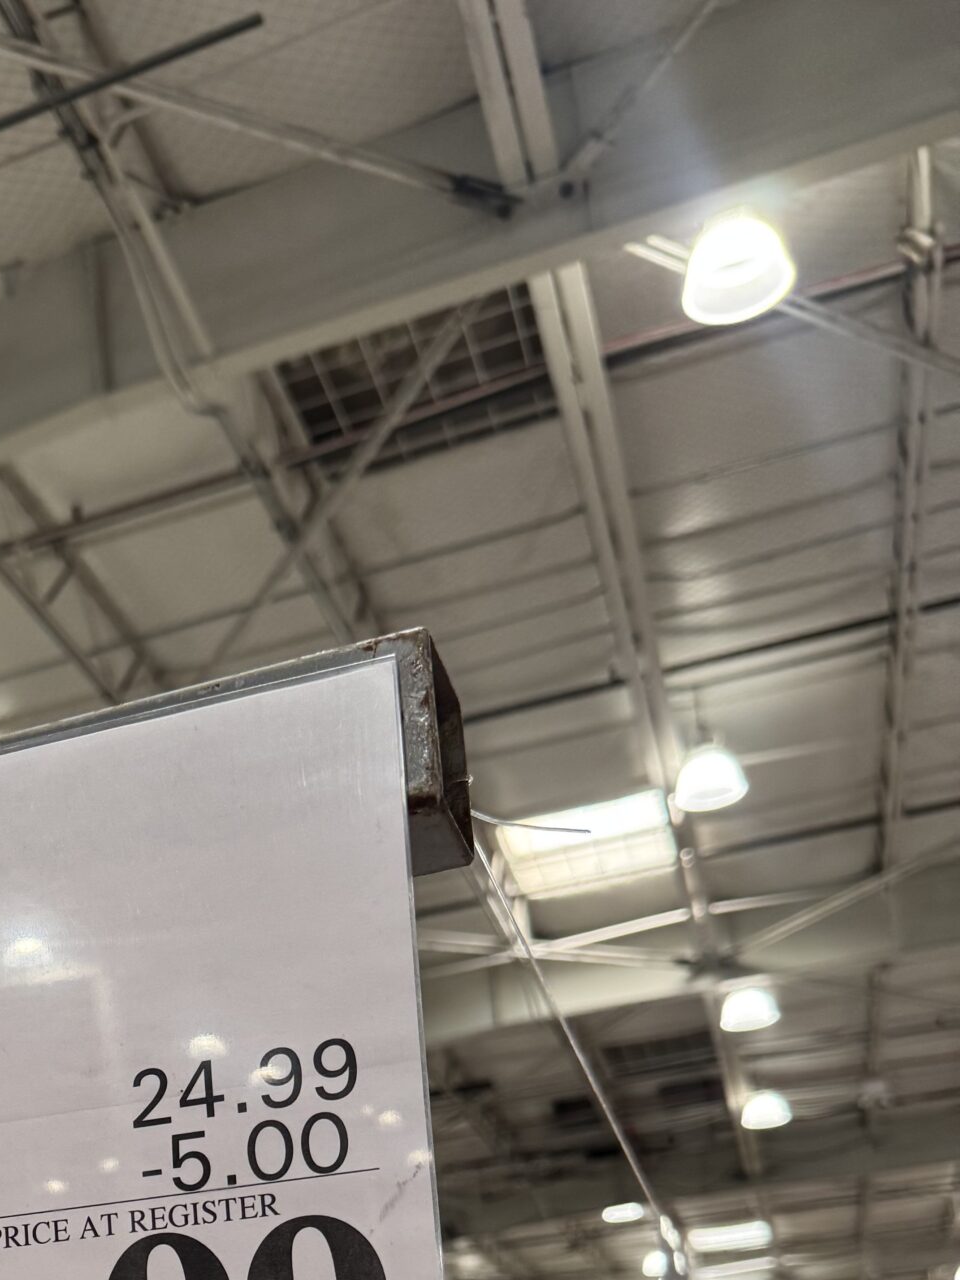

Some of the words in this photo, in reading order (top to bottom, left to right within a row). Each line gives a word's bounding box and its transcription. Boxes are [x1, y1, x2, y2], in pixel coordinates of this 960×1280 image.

[132, 1037, 358, 1129] 24.99
[140, 1110, 351, 1193] -5.00
[79, 1212, 119, 1240] AT
[127, 1192, 281, 1234] REGISTER
